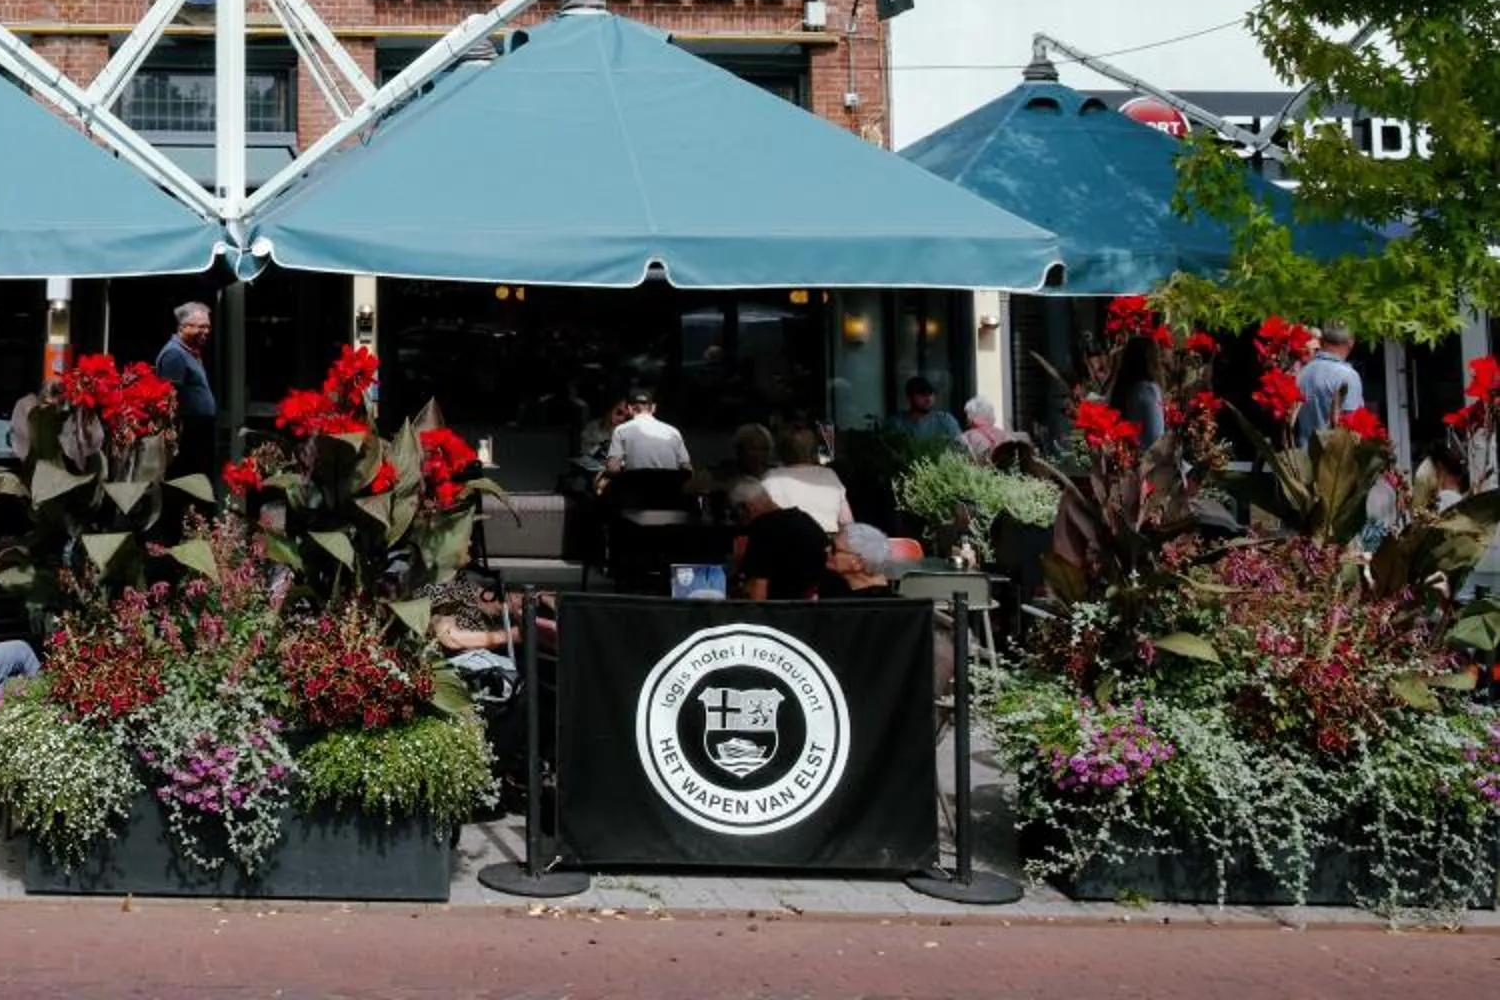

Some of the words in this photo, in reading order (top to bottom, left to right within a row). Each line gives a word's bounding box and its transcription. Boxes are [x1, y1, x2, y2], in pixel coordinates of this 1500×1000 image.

[661, 671, 691, 709] logis
[752, 648, 824, 712] restaurant
[659, 737, 684, 776] HET
[682, 776, 749, 815] WAPEN
[756, 789, 795, 814] VAN
[794, 742, 825, 790] ELST
